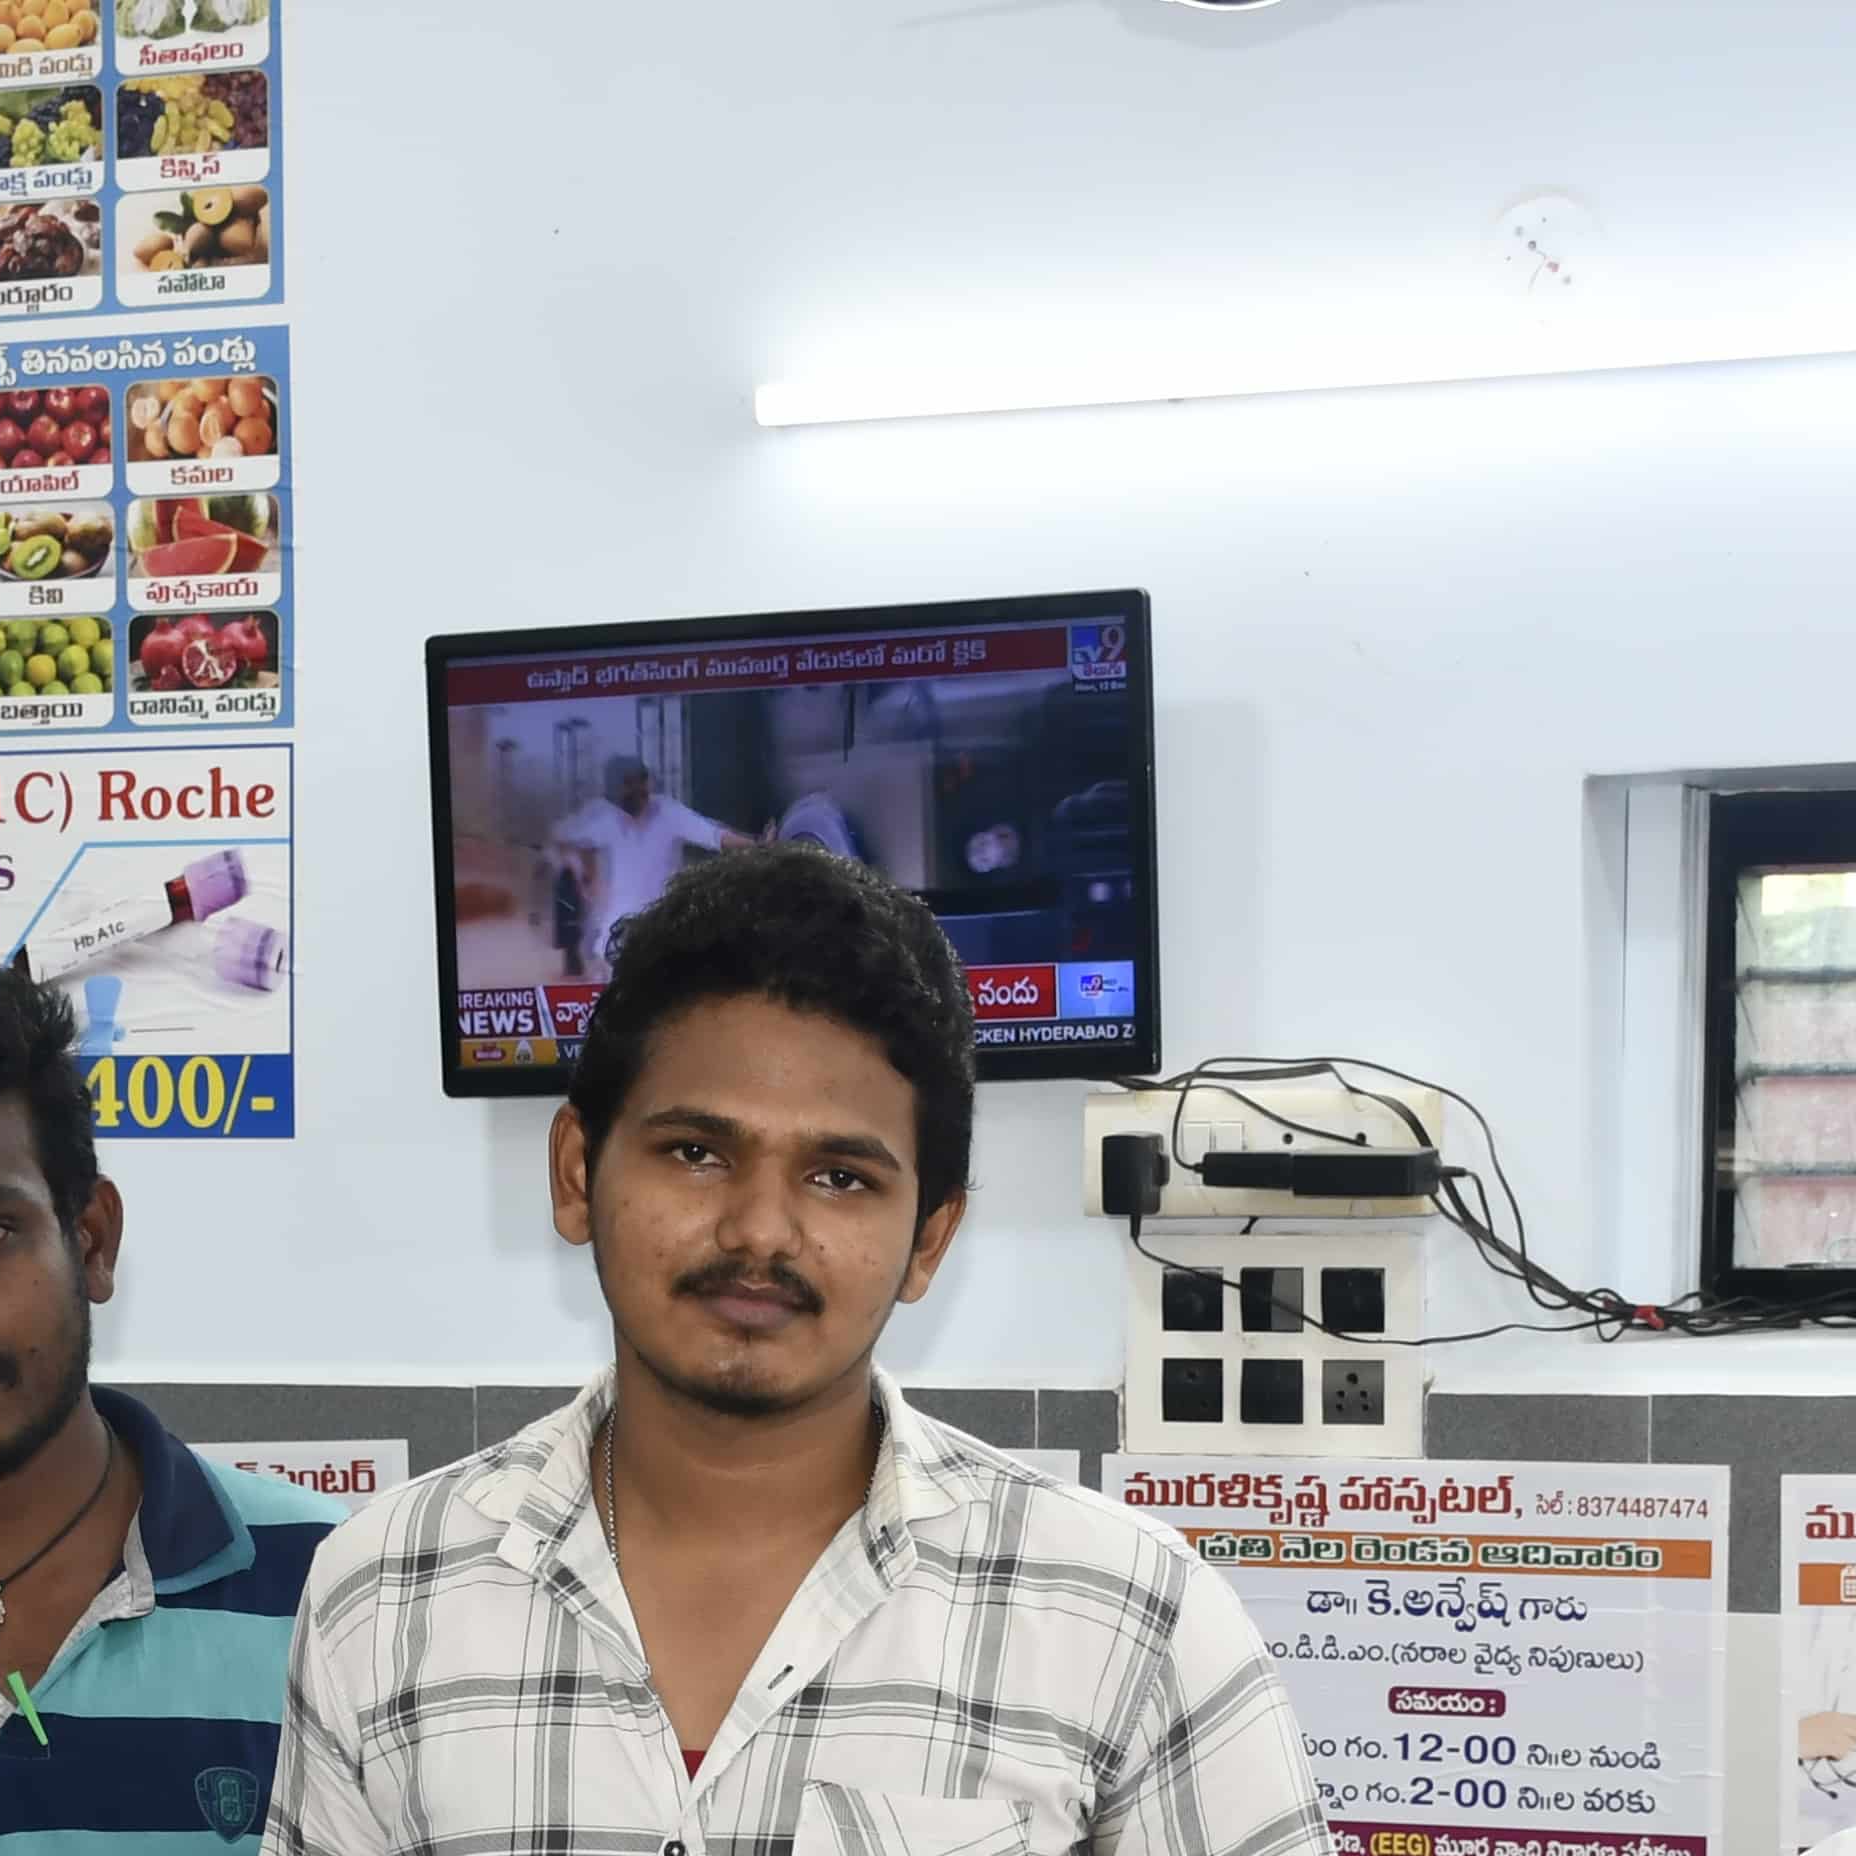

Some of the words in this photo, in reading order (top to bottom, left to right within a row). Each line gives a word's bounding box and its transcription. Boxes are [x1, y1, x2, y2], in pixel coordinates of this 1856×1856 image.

[139, 38, 244, 66] సీతాఫలం
[38, 54, 94, 80] పండ్లు
[35, 169, 93, 192] పండ్లు
[157, 273, 226, 296] సపోటా
[21, 342, 166, 377] తినవలసిన
[173, 336, 256, 371] పండ్లు
[0, 470, 79, 495] యాపిల్
[171, 464, 233, 485] కమల
[29, 585, 63, 606] కివి
[146, 578, 259, 603] పుచ్చకాయ
[129, 695, 208, 720] దానిమ్మ
[215, 689, 276, 719] పండ్లు
[97, 766, 275, 821] Roche
[1019, 1024, 1118, 1042] HYDERABAD
[1197, 1534, 1274, 1566] ప్రతి
[1280, 1537, 1346, 1563] నెల
[1352, 1541, 1471, 1566] రెండవ
[1480, 1545, 1661, 1570] ఆదివారం
[1519, 1596, 1588, 1623] గారు
[1472, 1642, 1522, 1674] వైద్య
[1589, 1741, 1662, 1771] నుండి
[1582, 1790, 1656, 1816] వరకు
